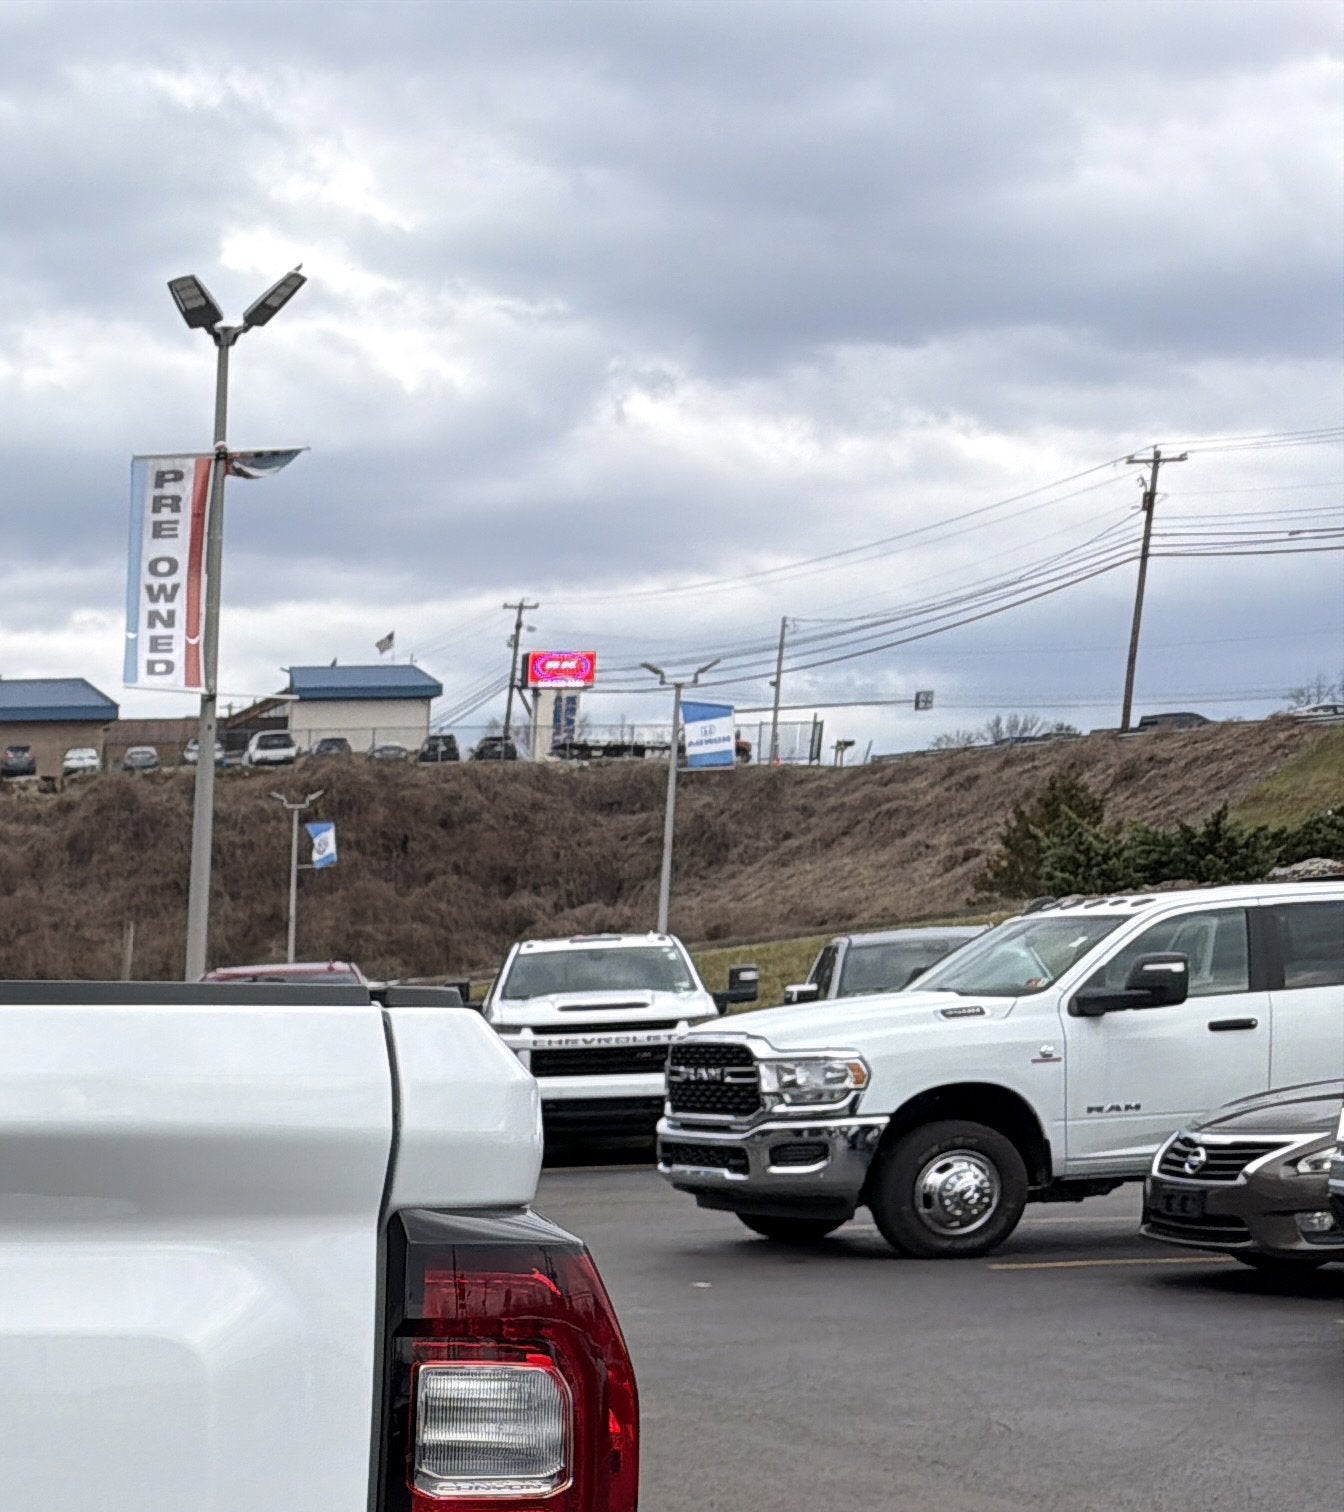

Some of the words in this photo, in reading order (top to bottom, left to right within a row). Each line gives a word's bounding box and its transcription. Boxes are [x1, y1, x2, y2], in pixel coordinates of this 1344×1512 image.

[151, 469, 185, 540] PRE
[144, 556, 181, 676] OWNED
[532, 1034, 678, 1047] CHEVROLET
[1086, 1102, 1141, 1113] RAM
